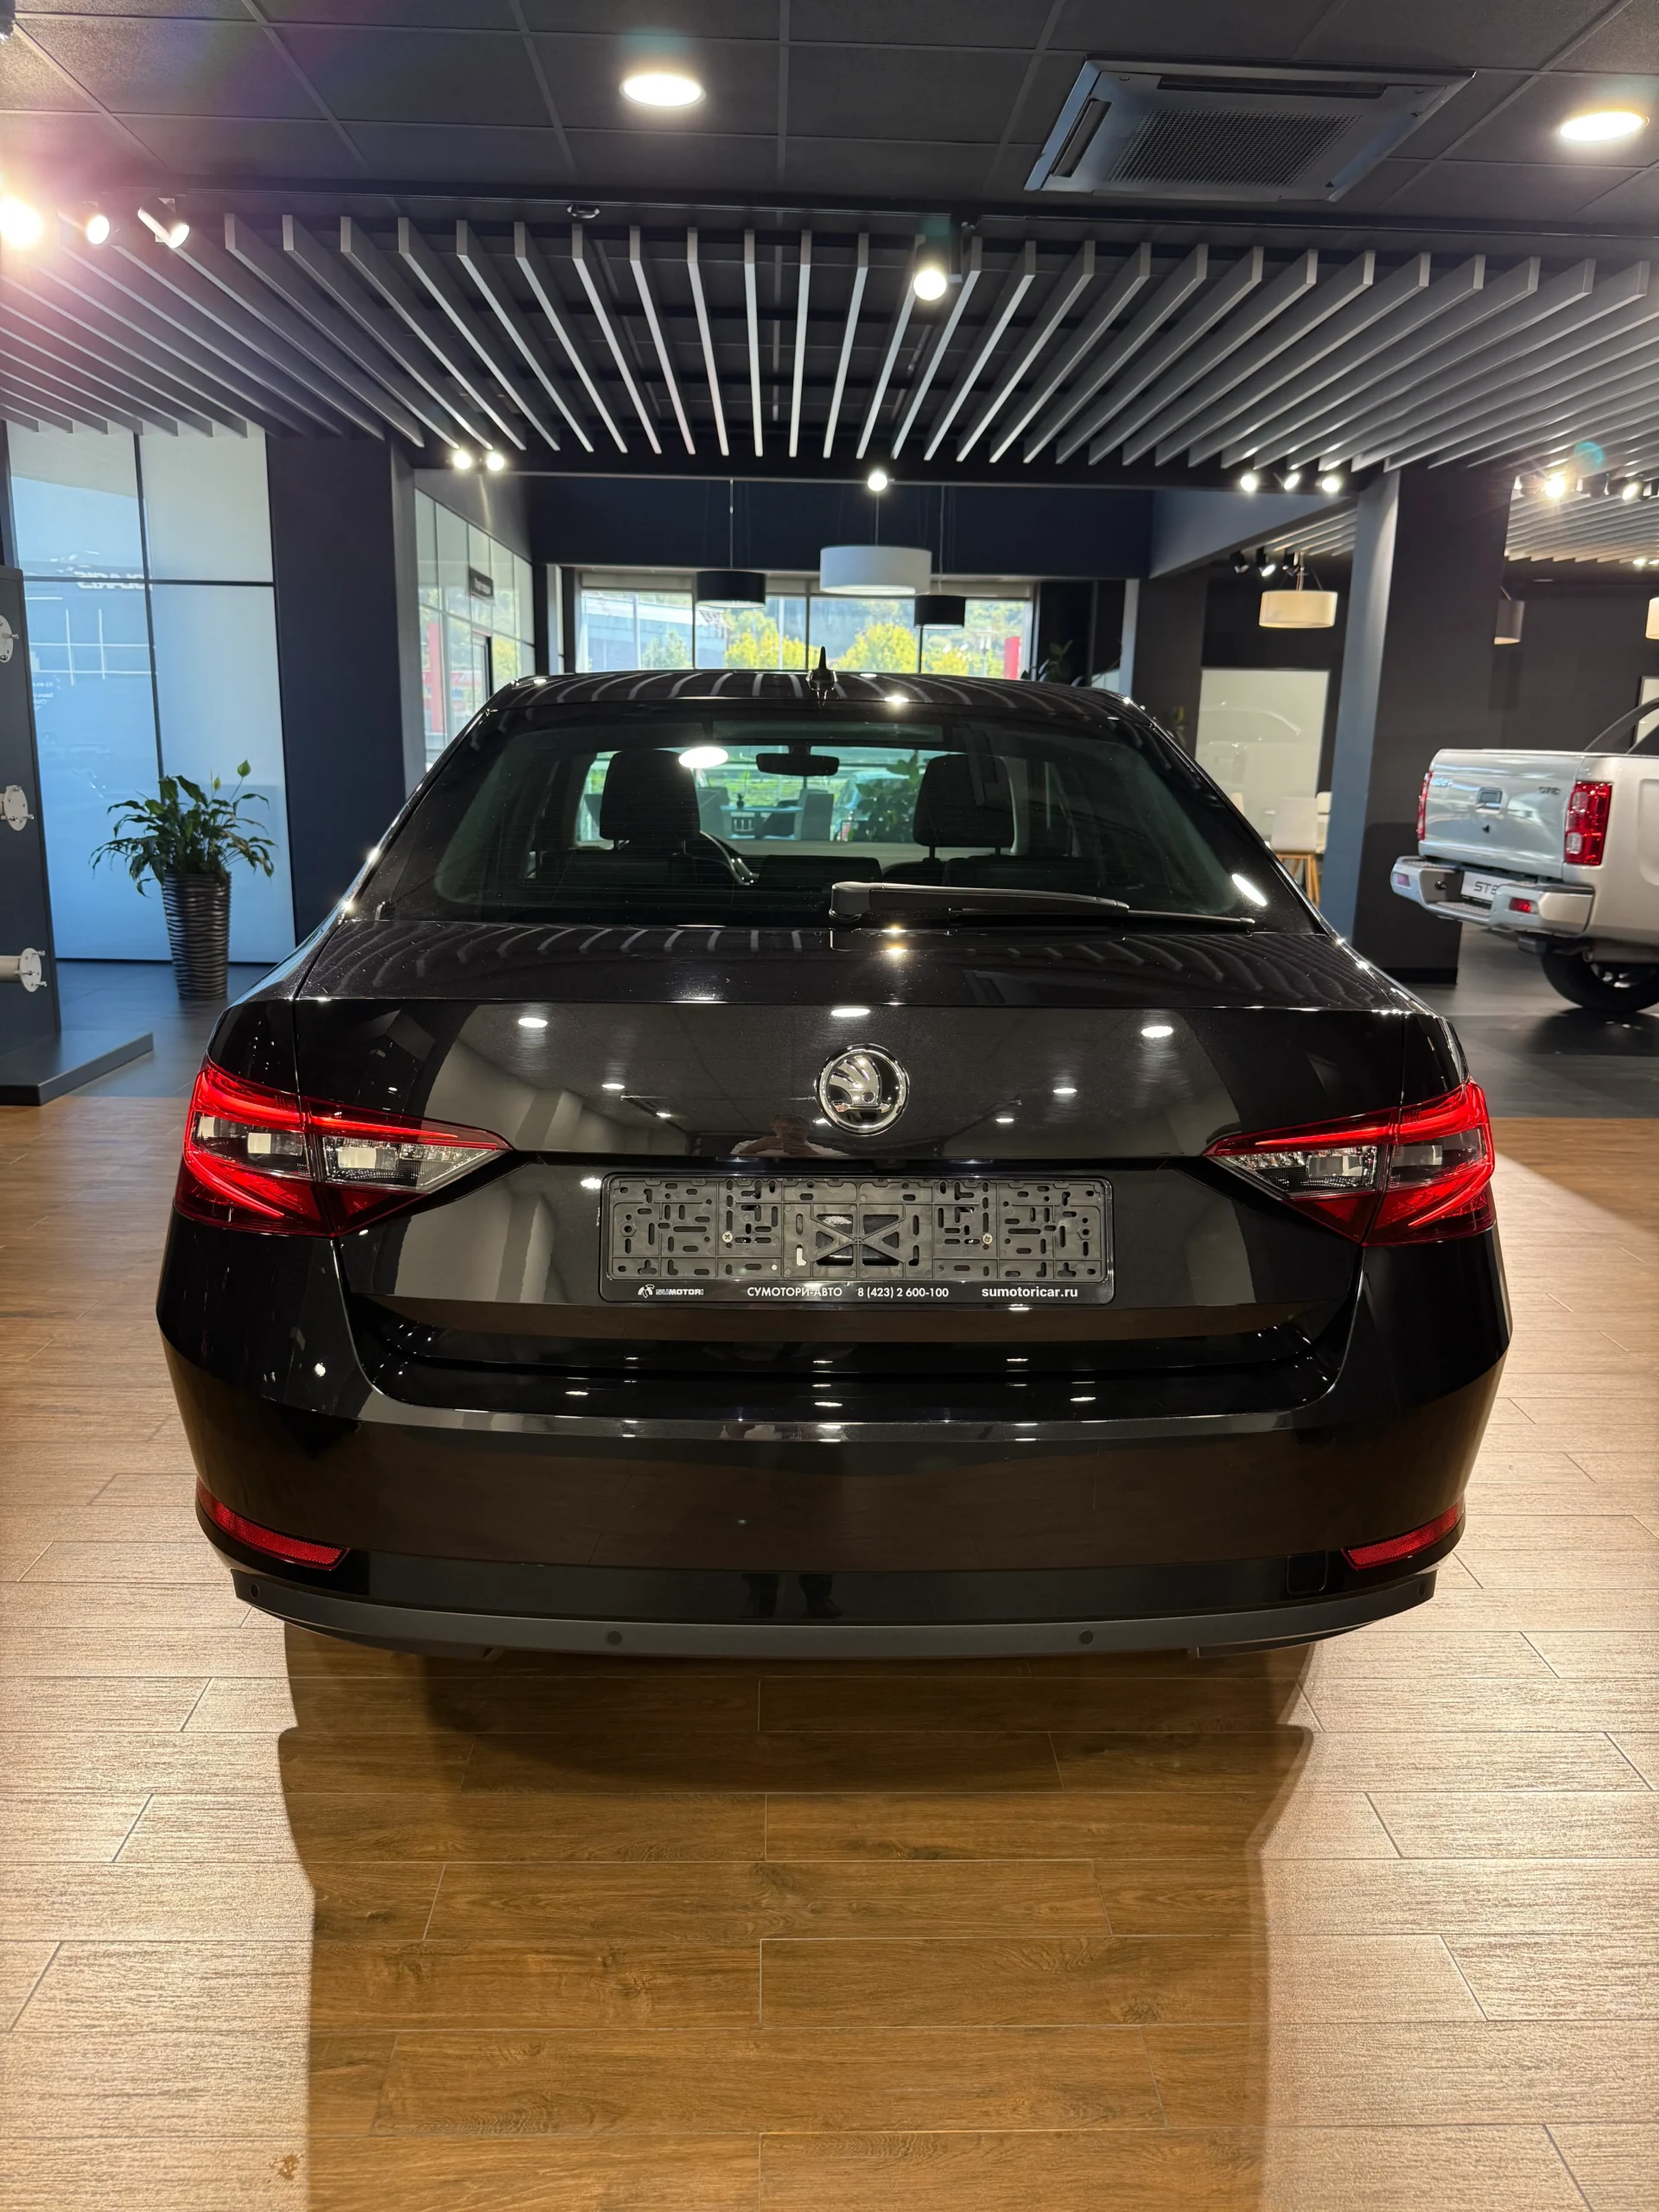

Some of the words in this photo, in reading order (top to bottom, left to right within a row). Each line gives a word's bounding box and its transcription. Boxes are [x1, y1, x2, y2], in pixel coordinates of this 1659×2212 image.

[747, 1287, 843, 1298] СУМОТОРИ-АВТО
[857, 1287, 865, 1298] 8
[867, 1287, 894, 1299] (423)
[896, 1287, 904, 1298] 2
[906, 1287, 950, 1298] 600-100
[981, 1286, 1078, 1298] sumotoricar.ru
